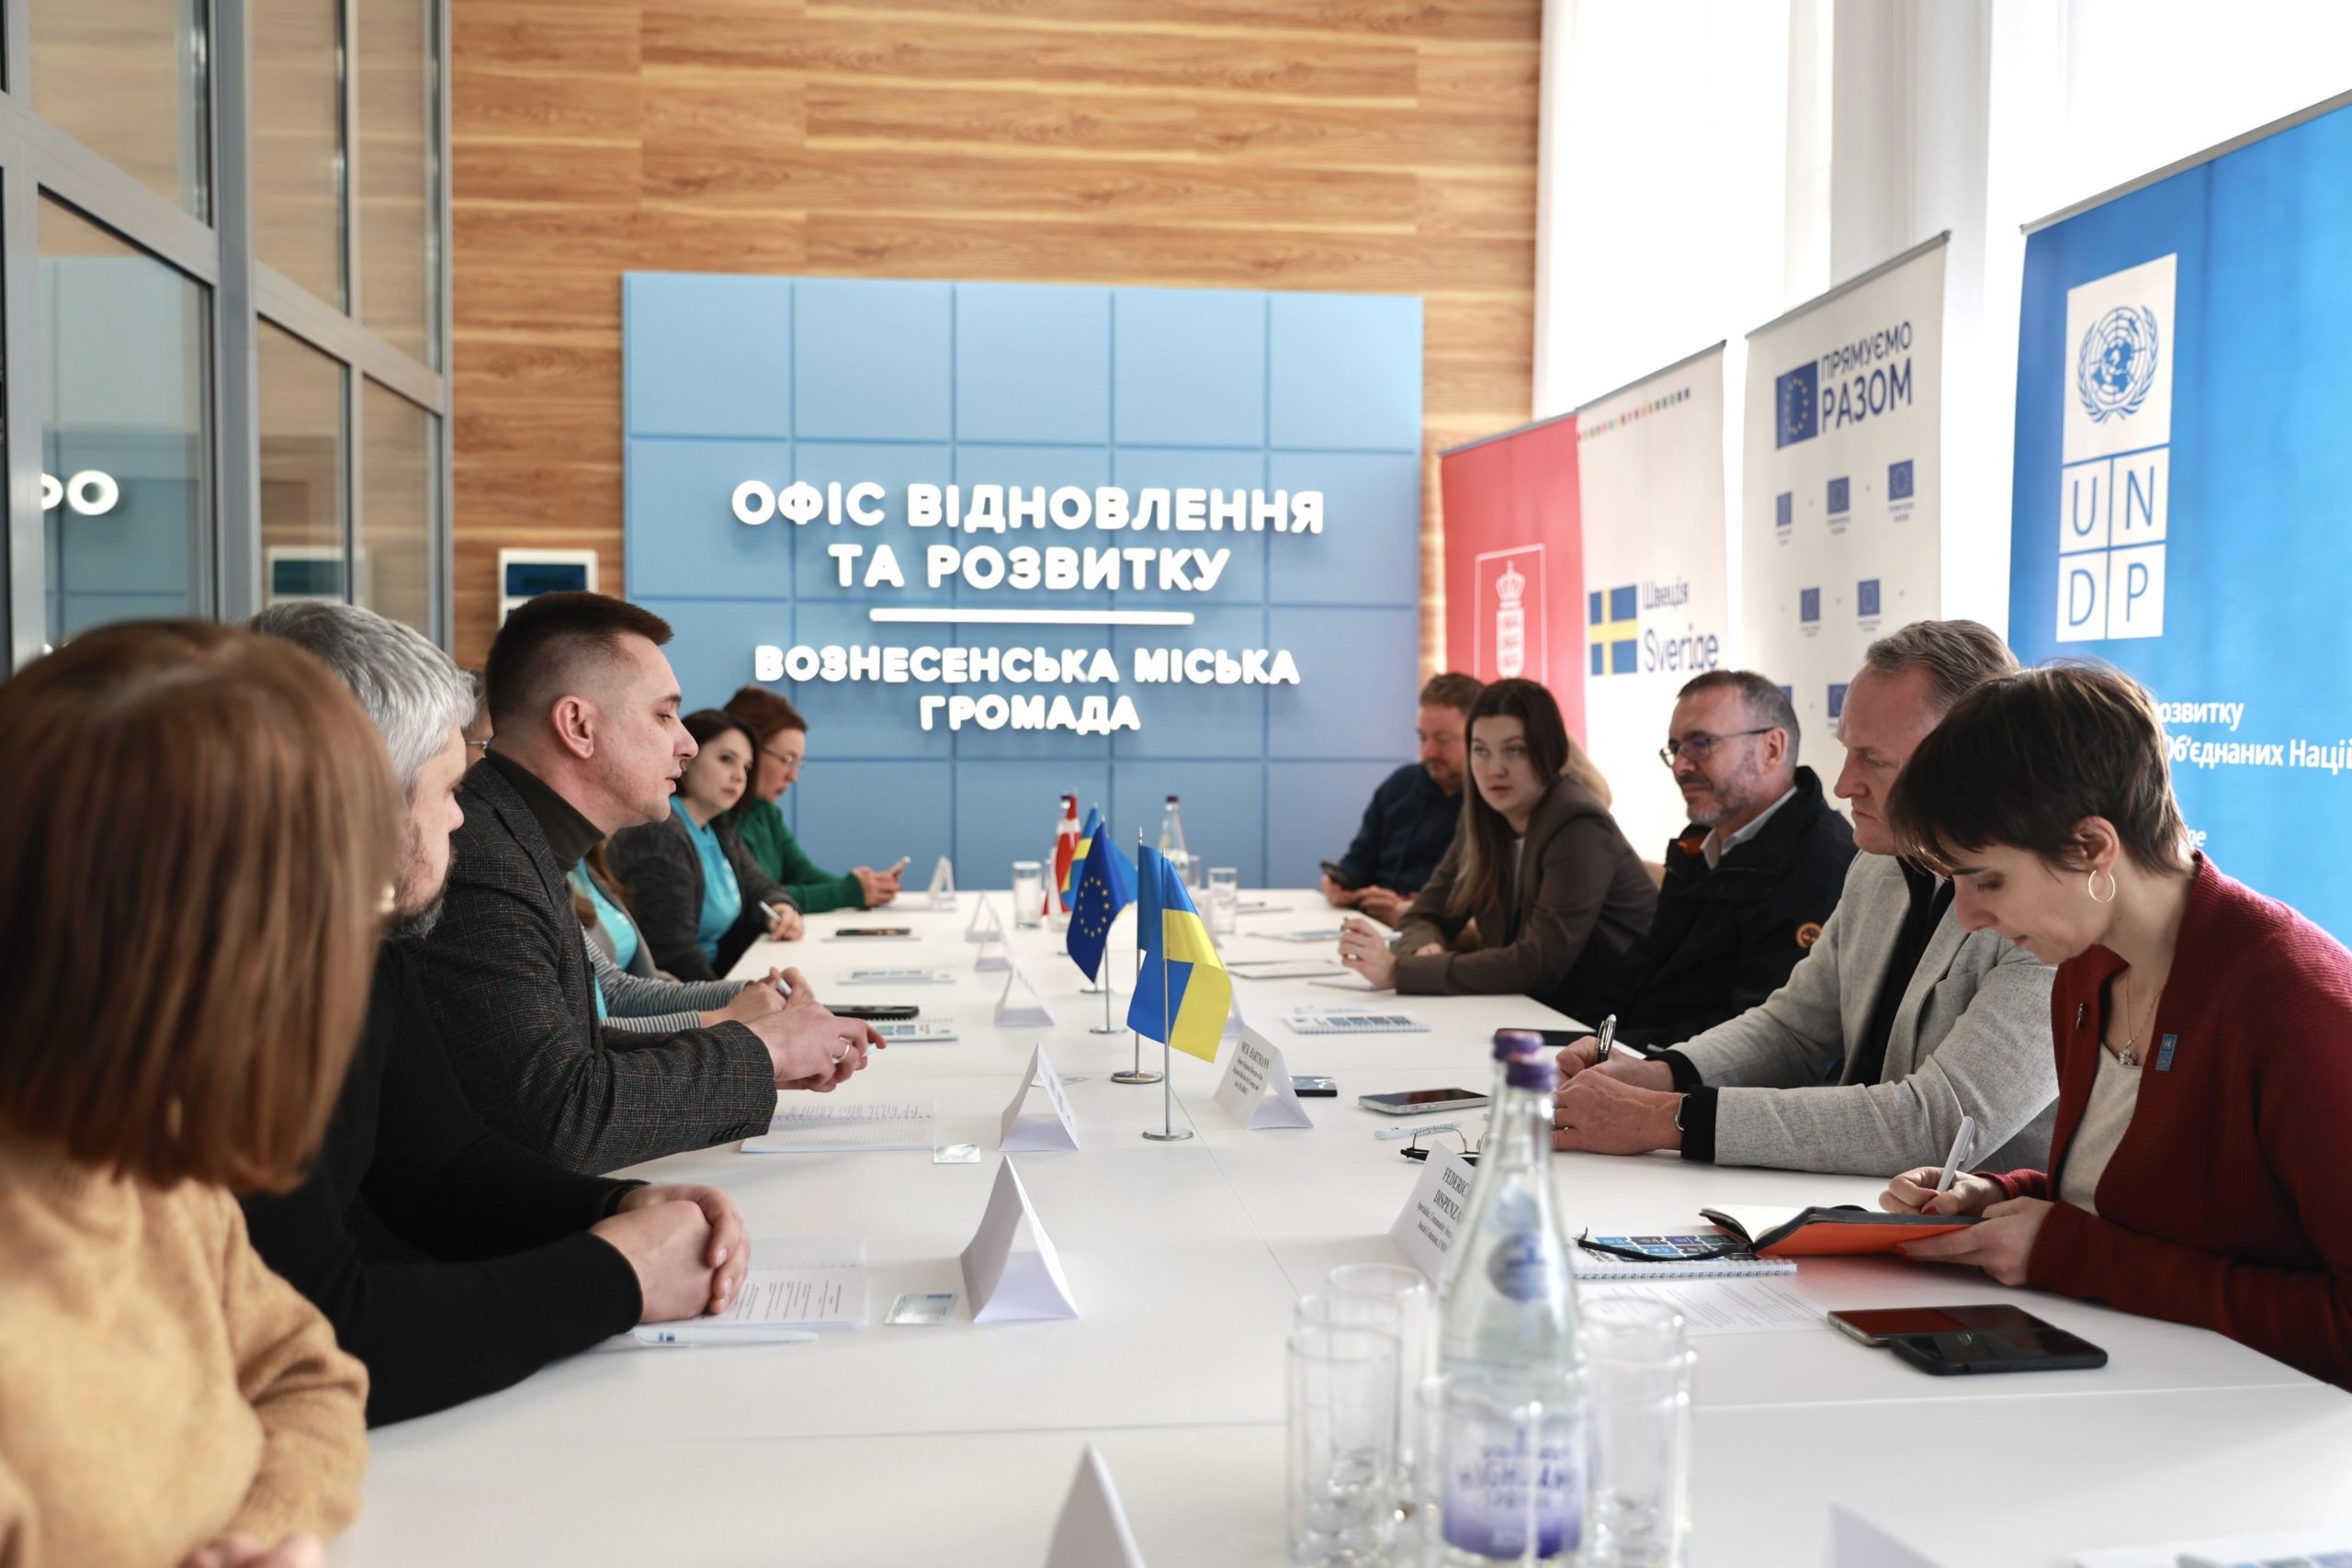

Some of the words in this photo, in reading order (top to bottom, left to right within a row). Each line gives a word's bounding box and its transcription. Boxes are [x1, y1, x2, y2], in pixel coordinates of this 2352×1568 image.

[1821, 321, 1912, 381] ПРЯМУЄМО
[1822, 357, 1912, 433] РАЗОМ
[731, 480, 886, 525] ОФІС
[908, 483, 1325, 534] ВІДНОВЛЕННЯ
[828, 545, 904, 588] ТА
[927, 545, 1231, 592] РОЗВИТКУ
[755, 646, 1120, 683] ВОЗНЕСЕНСЬКА
[1134, 649, 1300, 685] МІСЬКА
[920, 694, 1141, 736] ГРОМАДА
[2155, 702, 2245, 732] озвитку
[1442, 1167, 1470, 1198] FEDERIC
